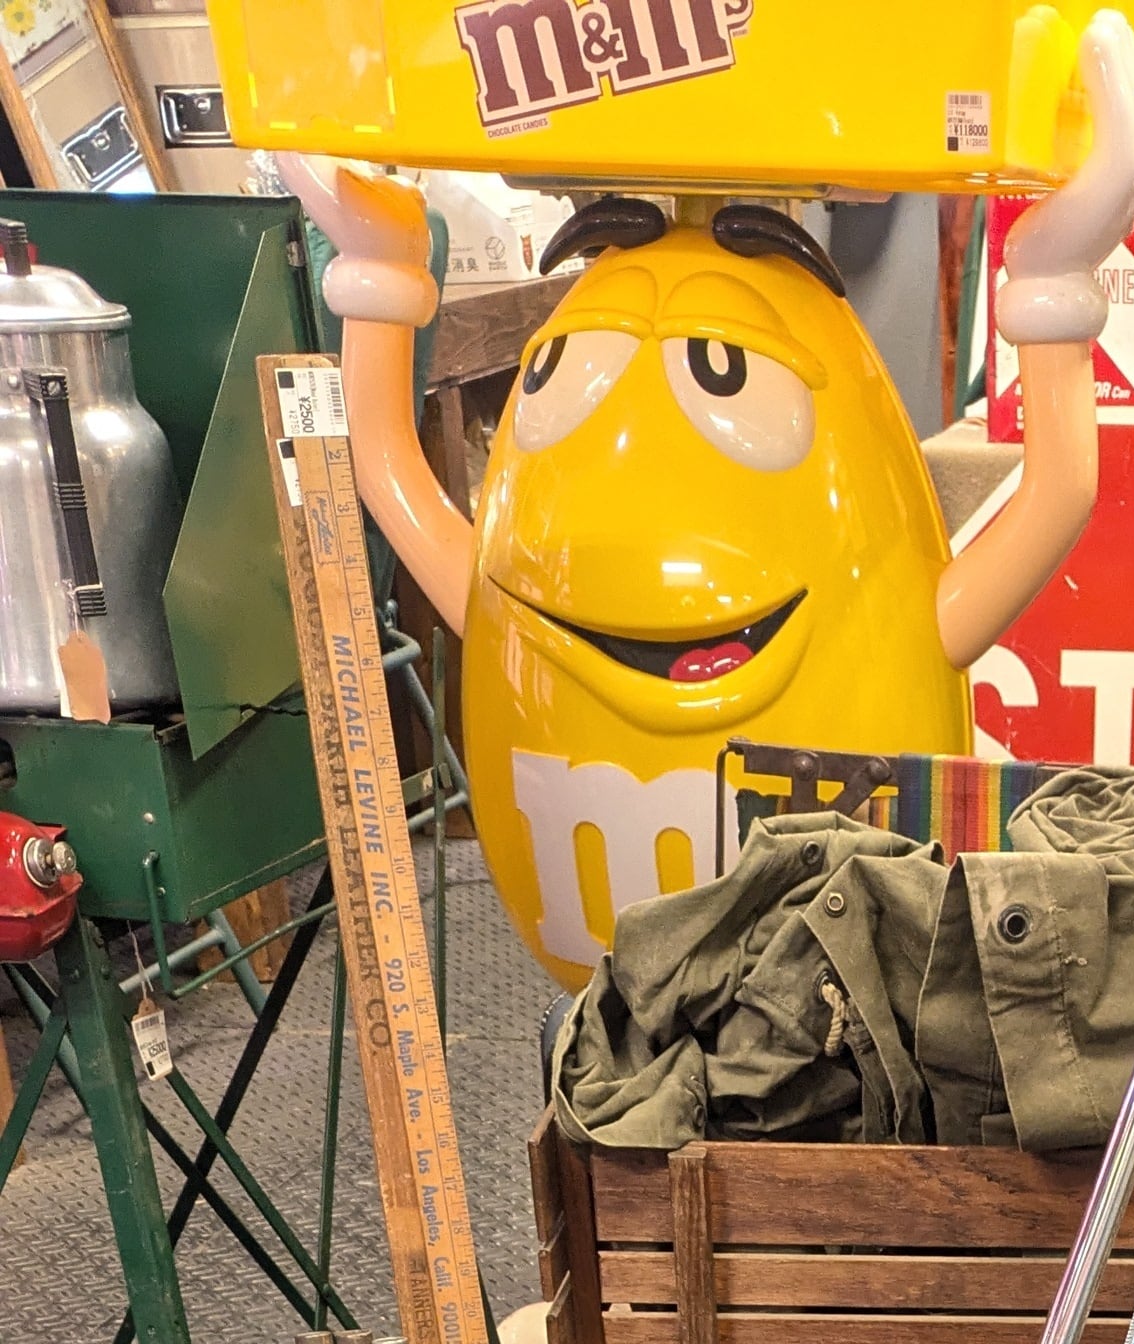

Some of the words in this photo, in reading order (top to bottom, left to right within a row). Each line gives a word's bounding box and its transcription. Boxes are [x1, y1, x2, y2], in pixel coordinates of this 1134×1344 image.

[488, 124, 521, 138] CHOCOLATE
[297, 395, 315, 434] ¥2500
[327, 448, 342, 461] 2
[336, 501, 350, 514] 3
[352, 605, 366, 617] 5
[360, 656, 373, 667] 6
[331, 632, 367, 752] MICHAEL
[368, 706, 381, 716] 7
[376, 755, 389, 766] 8
[354, 767, 383, 855] LEVINE
[384, 804, 396, 815] 9
[392, 856, 406, 875] 10
[370, 871, 393, 919] INC.
[400, 903, 414, 921] 11
[407, 950, 421, 969] 12
[384, 958, 405, 993] 920
[392, 1003, 410, 1019] S.
[415, 997, 429, 1015] 13
[396, 1029, 415, 1077] Maple
[422, 1041, 436, 1059] 14
[429, 1086, 443, 1104] 15
[405, 1088, 424, 1122] Ave.
[436, 1131, 451, 1148] 16
[415, 1149, 433, 1174] Los
[443, 1174, 457, 1193] 17
[420, 1185, 439, 1246] Angeles,
[450, 1217, 464, 1235] 18
[433, 1257, 450, 1292] Calif.
[457, 1259, 471, 1277] 19
[463, 1300, 477, 1318] 20
